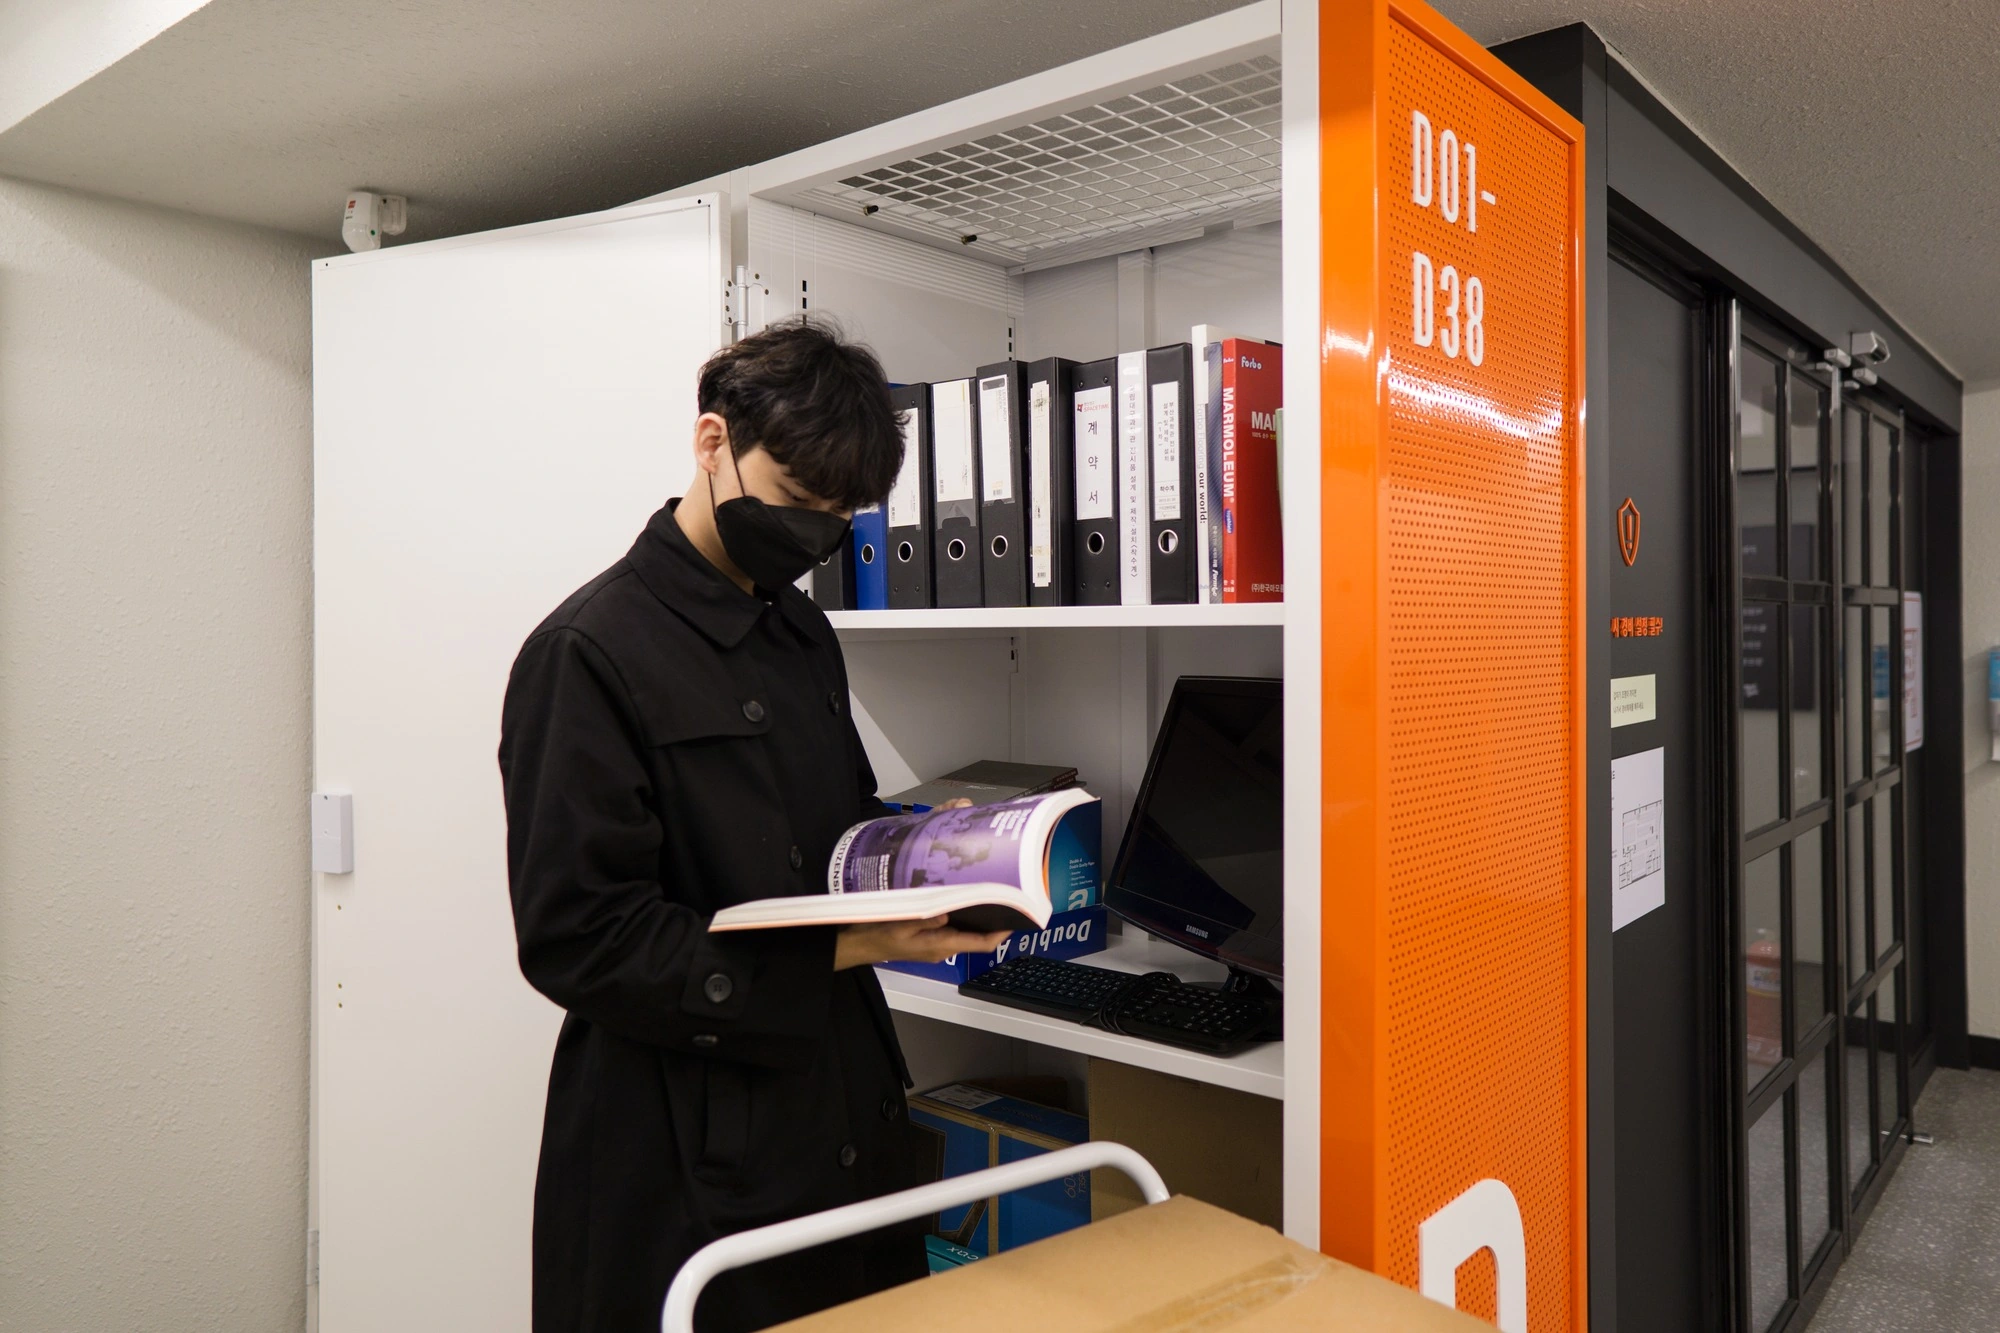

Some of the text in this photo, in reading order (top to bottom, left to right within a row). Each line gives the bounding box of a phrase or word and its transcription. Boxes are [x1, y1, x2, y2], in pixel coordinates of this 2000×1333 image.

[1413, 110, 1496, 233] D01-
[1413, 251, 1484, 367] D38
[1223, 387, 1235, 497] MARMOLEUM
[1019, 920, 1092, 955] Double
